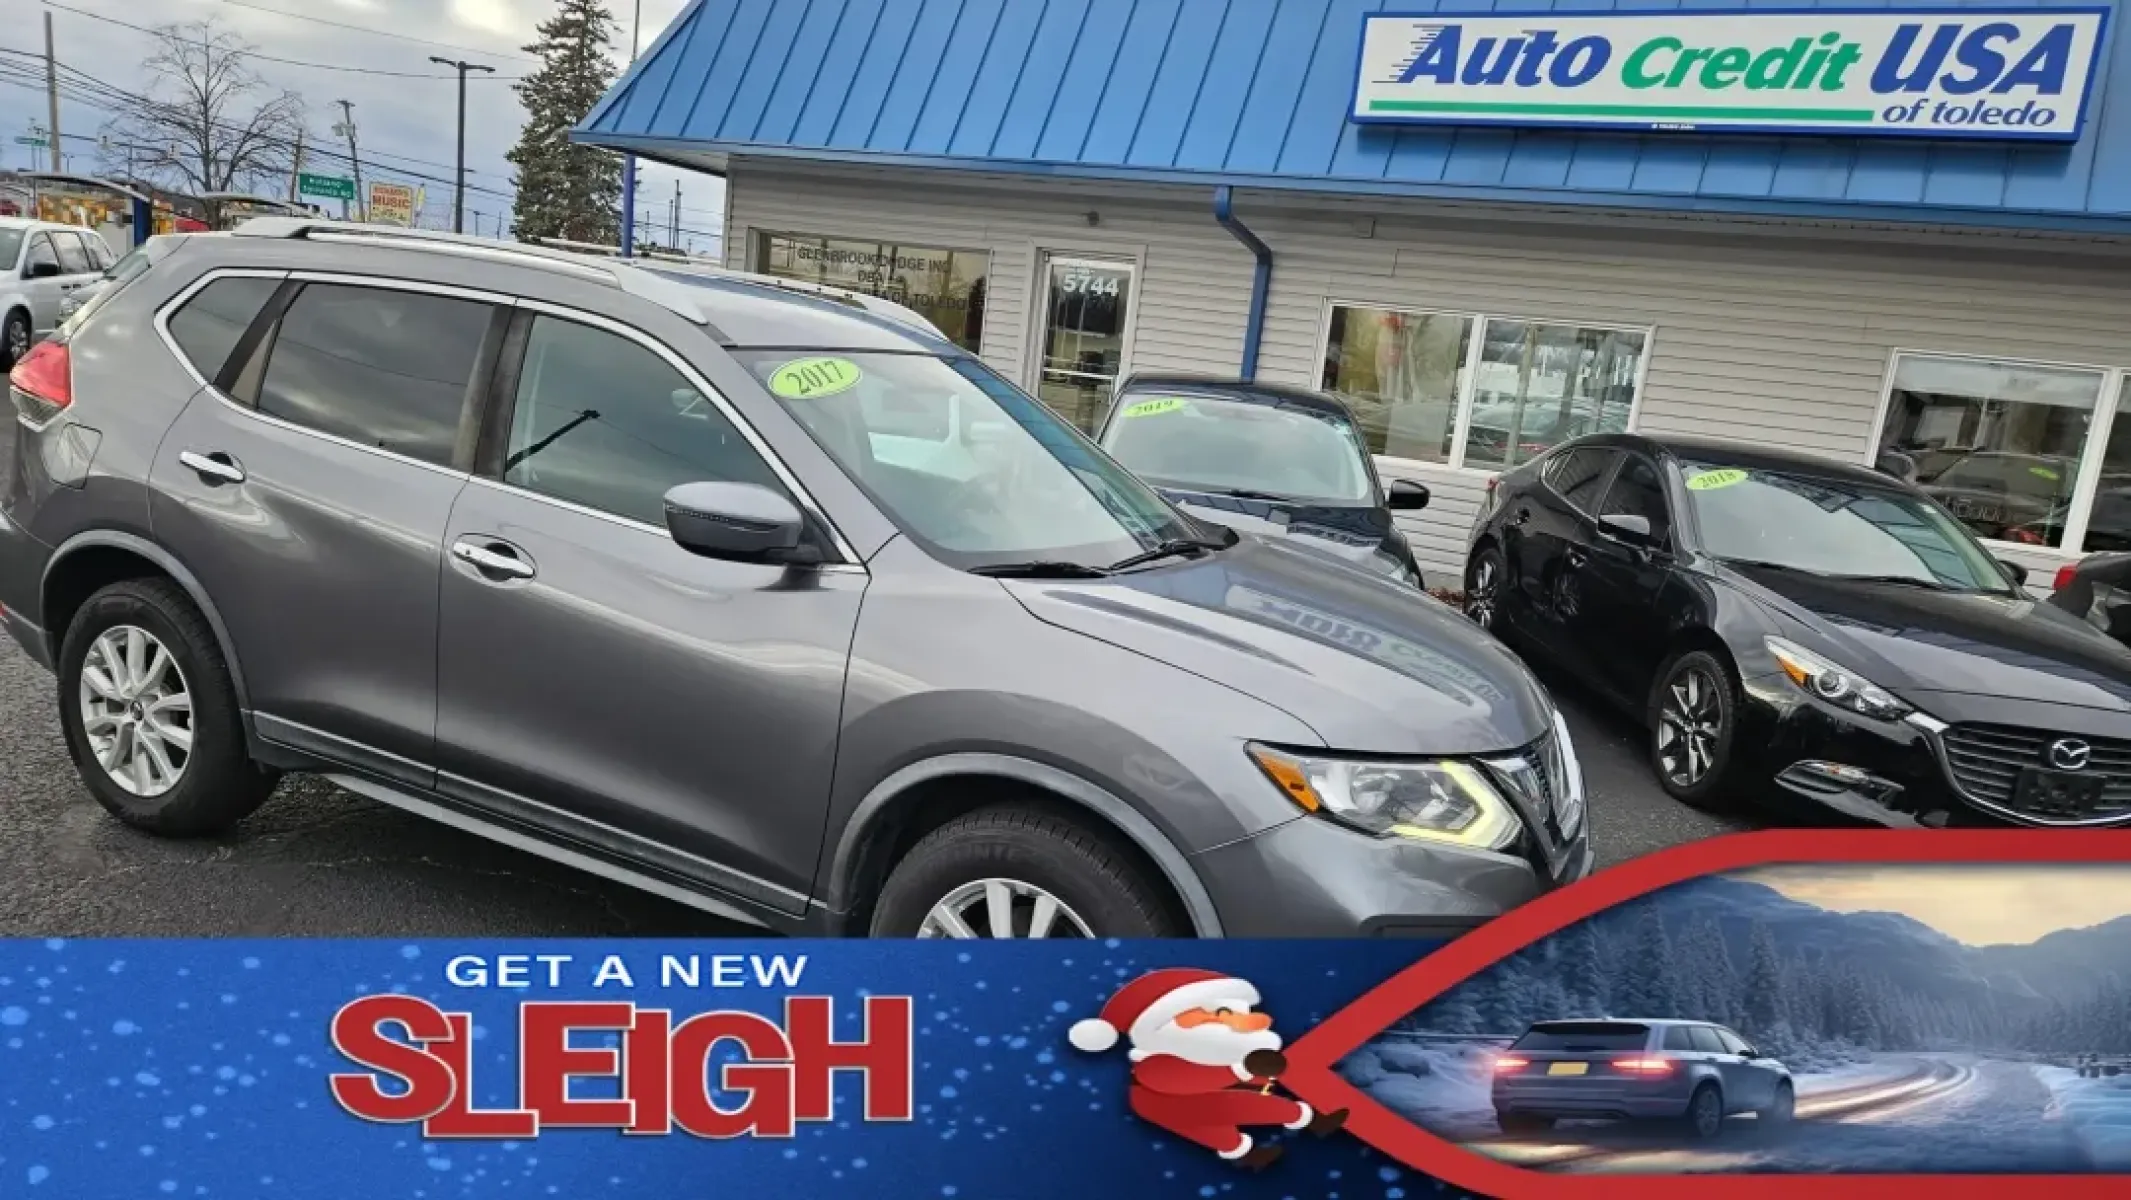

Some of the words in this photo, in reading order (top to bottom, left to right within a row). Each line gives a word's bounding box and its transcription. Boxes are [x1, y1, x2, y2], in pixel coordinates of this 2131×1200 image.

[1393, 23, 1612, 88] Auto
[1621, 31, 1861, 90] Credit
[1870, 22, 2076, 95] USA
[1882, 98, 1926, 125] of
[1932, 99, 2057, 127] toledo
[372, 195, 411, 209] MUSIC
[1063, 274, 1119, 296] 5744
[785, 360, 843, 394] 2017
